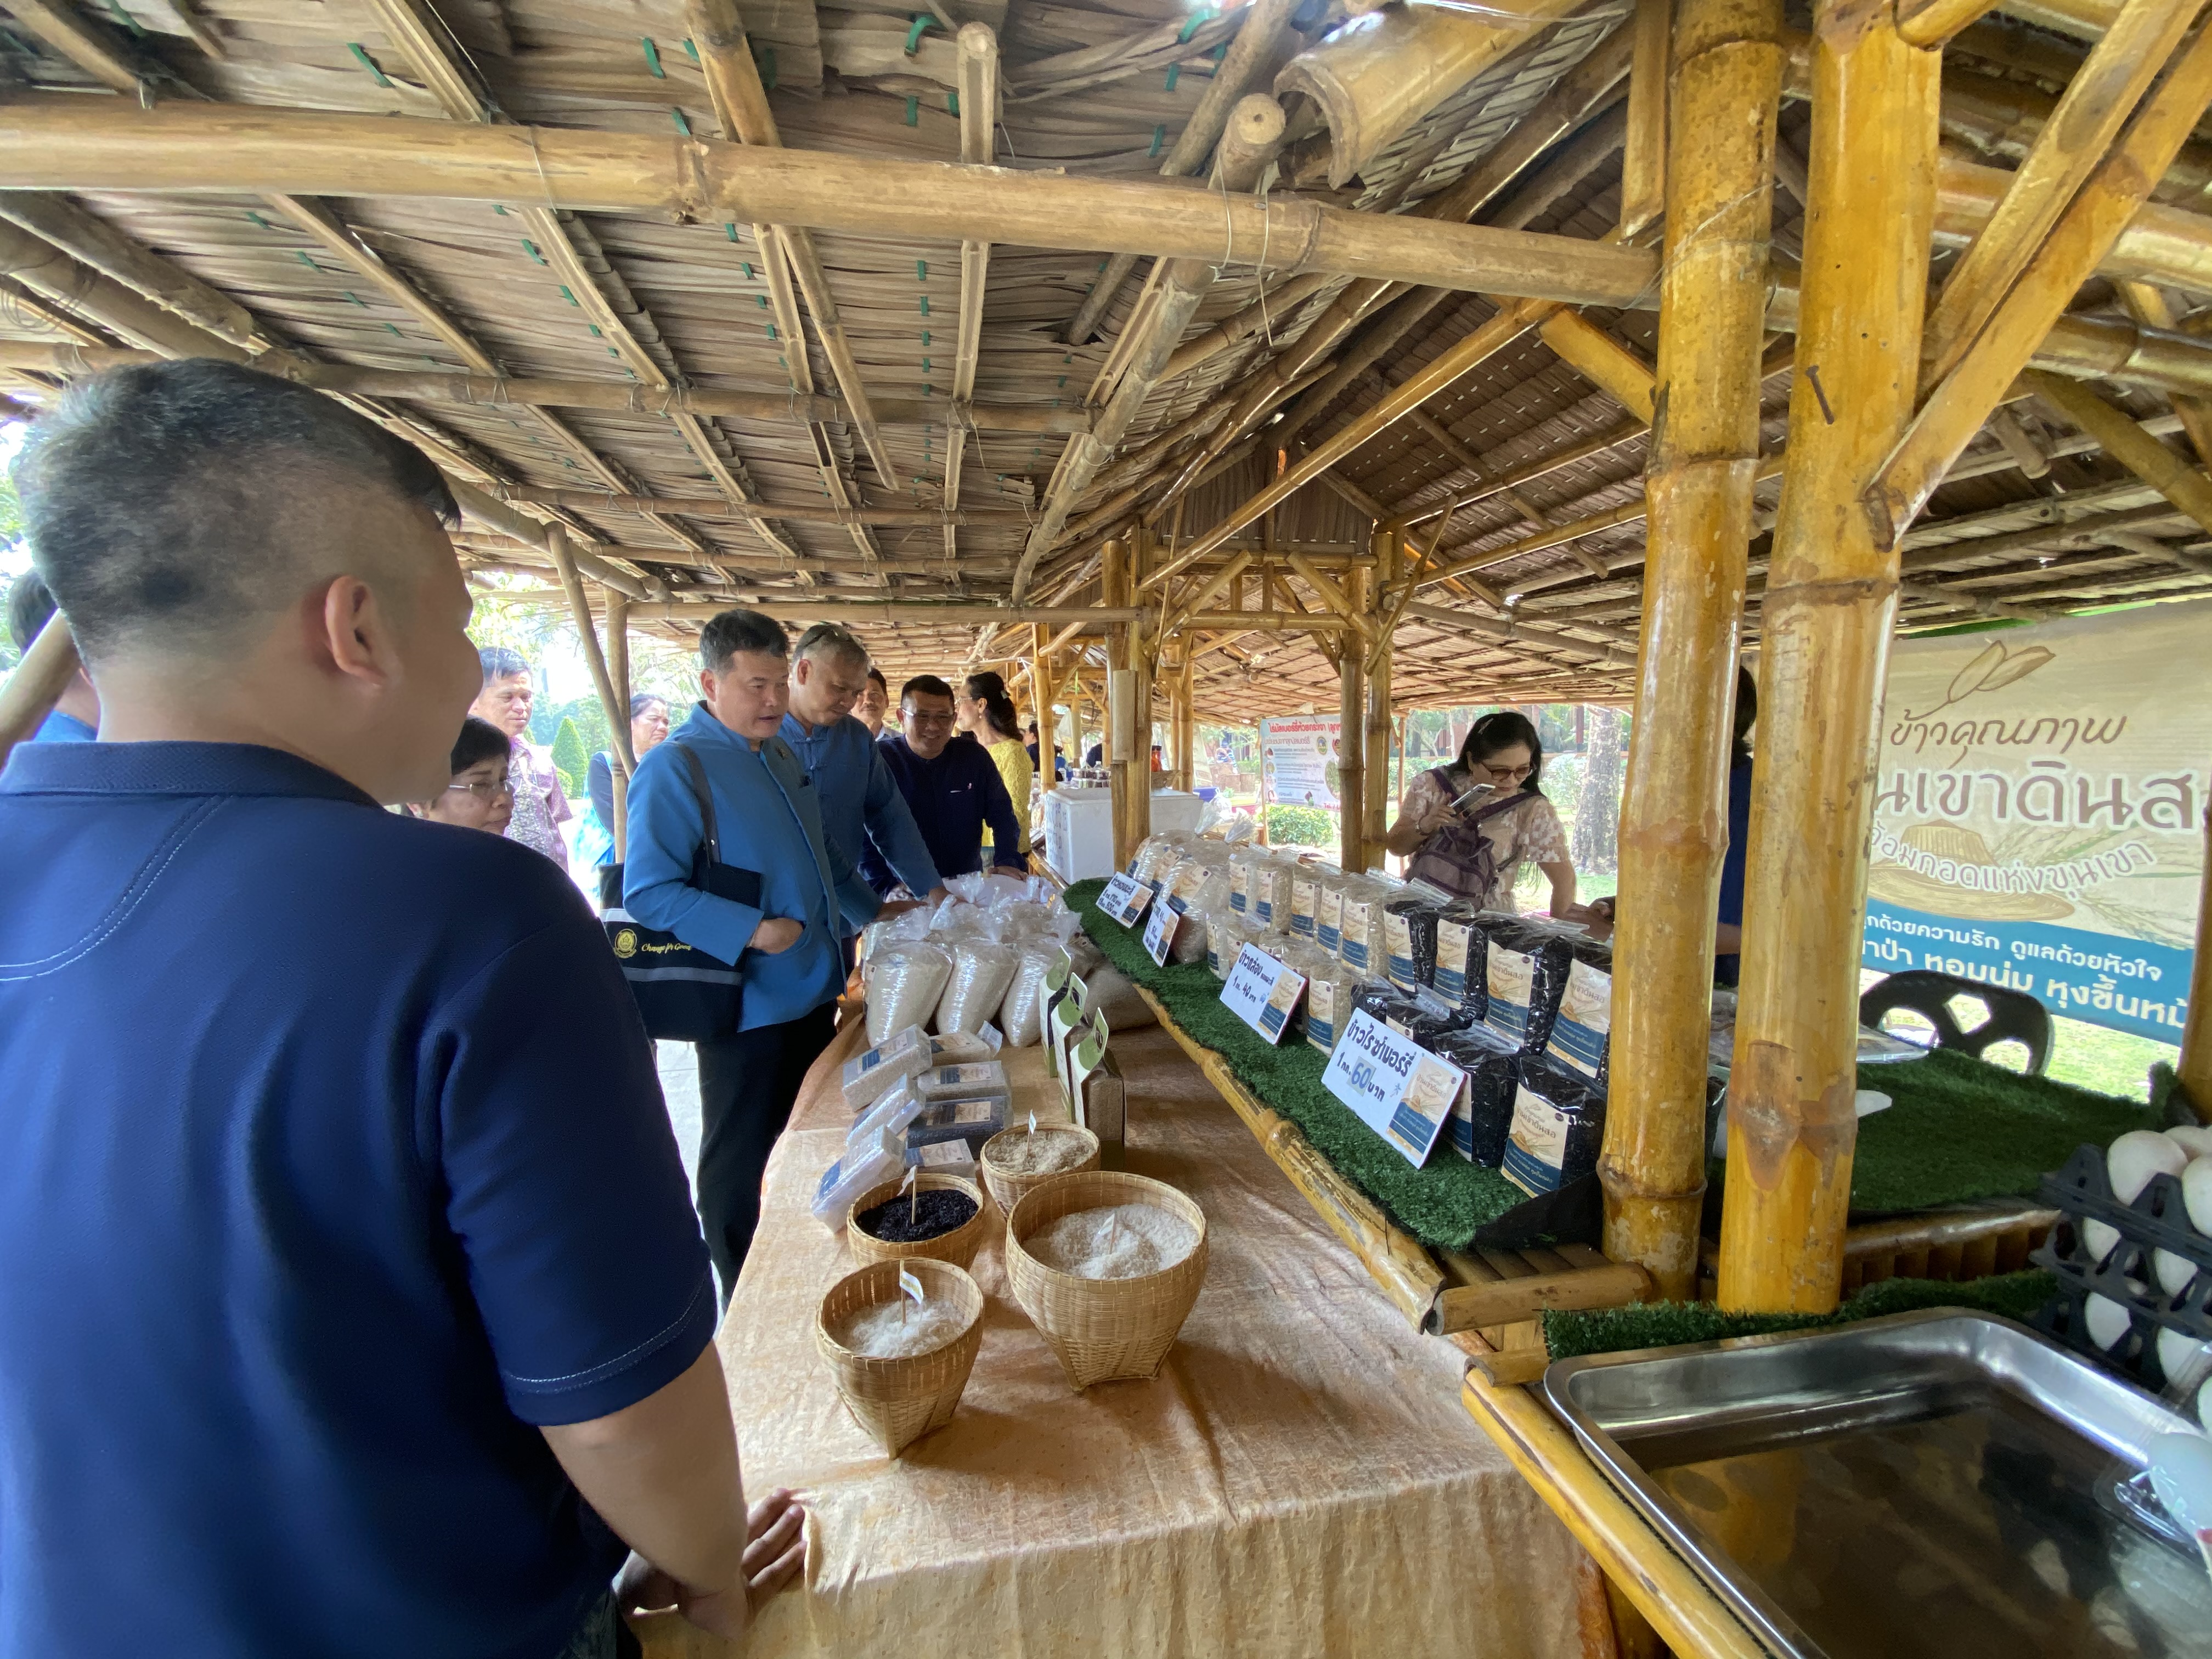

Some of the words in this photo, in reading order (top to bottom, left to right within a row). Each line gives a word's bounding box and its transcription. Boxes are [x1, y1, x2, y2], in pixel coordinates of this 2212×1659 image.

[1890, 709, 2128, 769] ข้าวคุณภาพ
[1877, 760, 2194, 829] นเขาดินส
[1862, 936, 1913, 966] าป่า
[1925, 952, 2033, 991] หอมน่ม
[2011, 939, 2163, 982] ดูแลด้วยหัวใจ
[1351, 1062, 1372, 1090] 60
